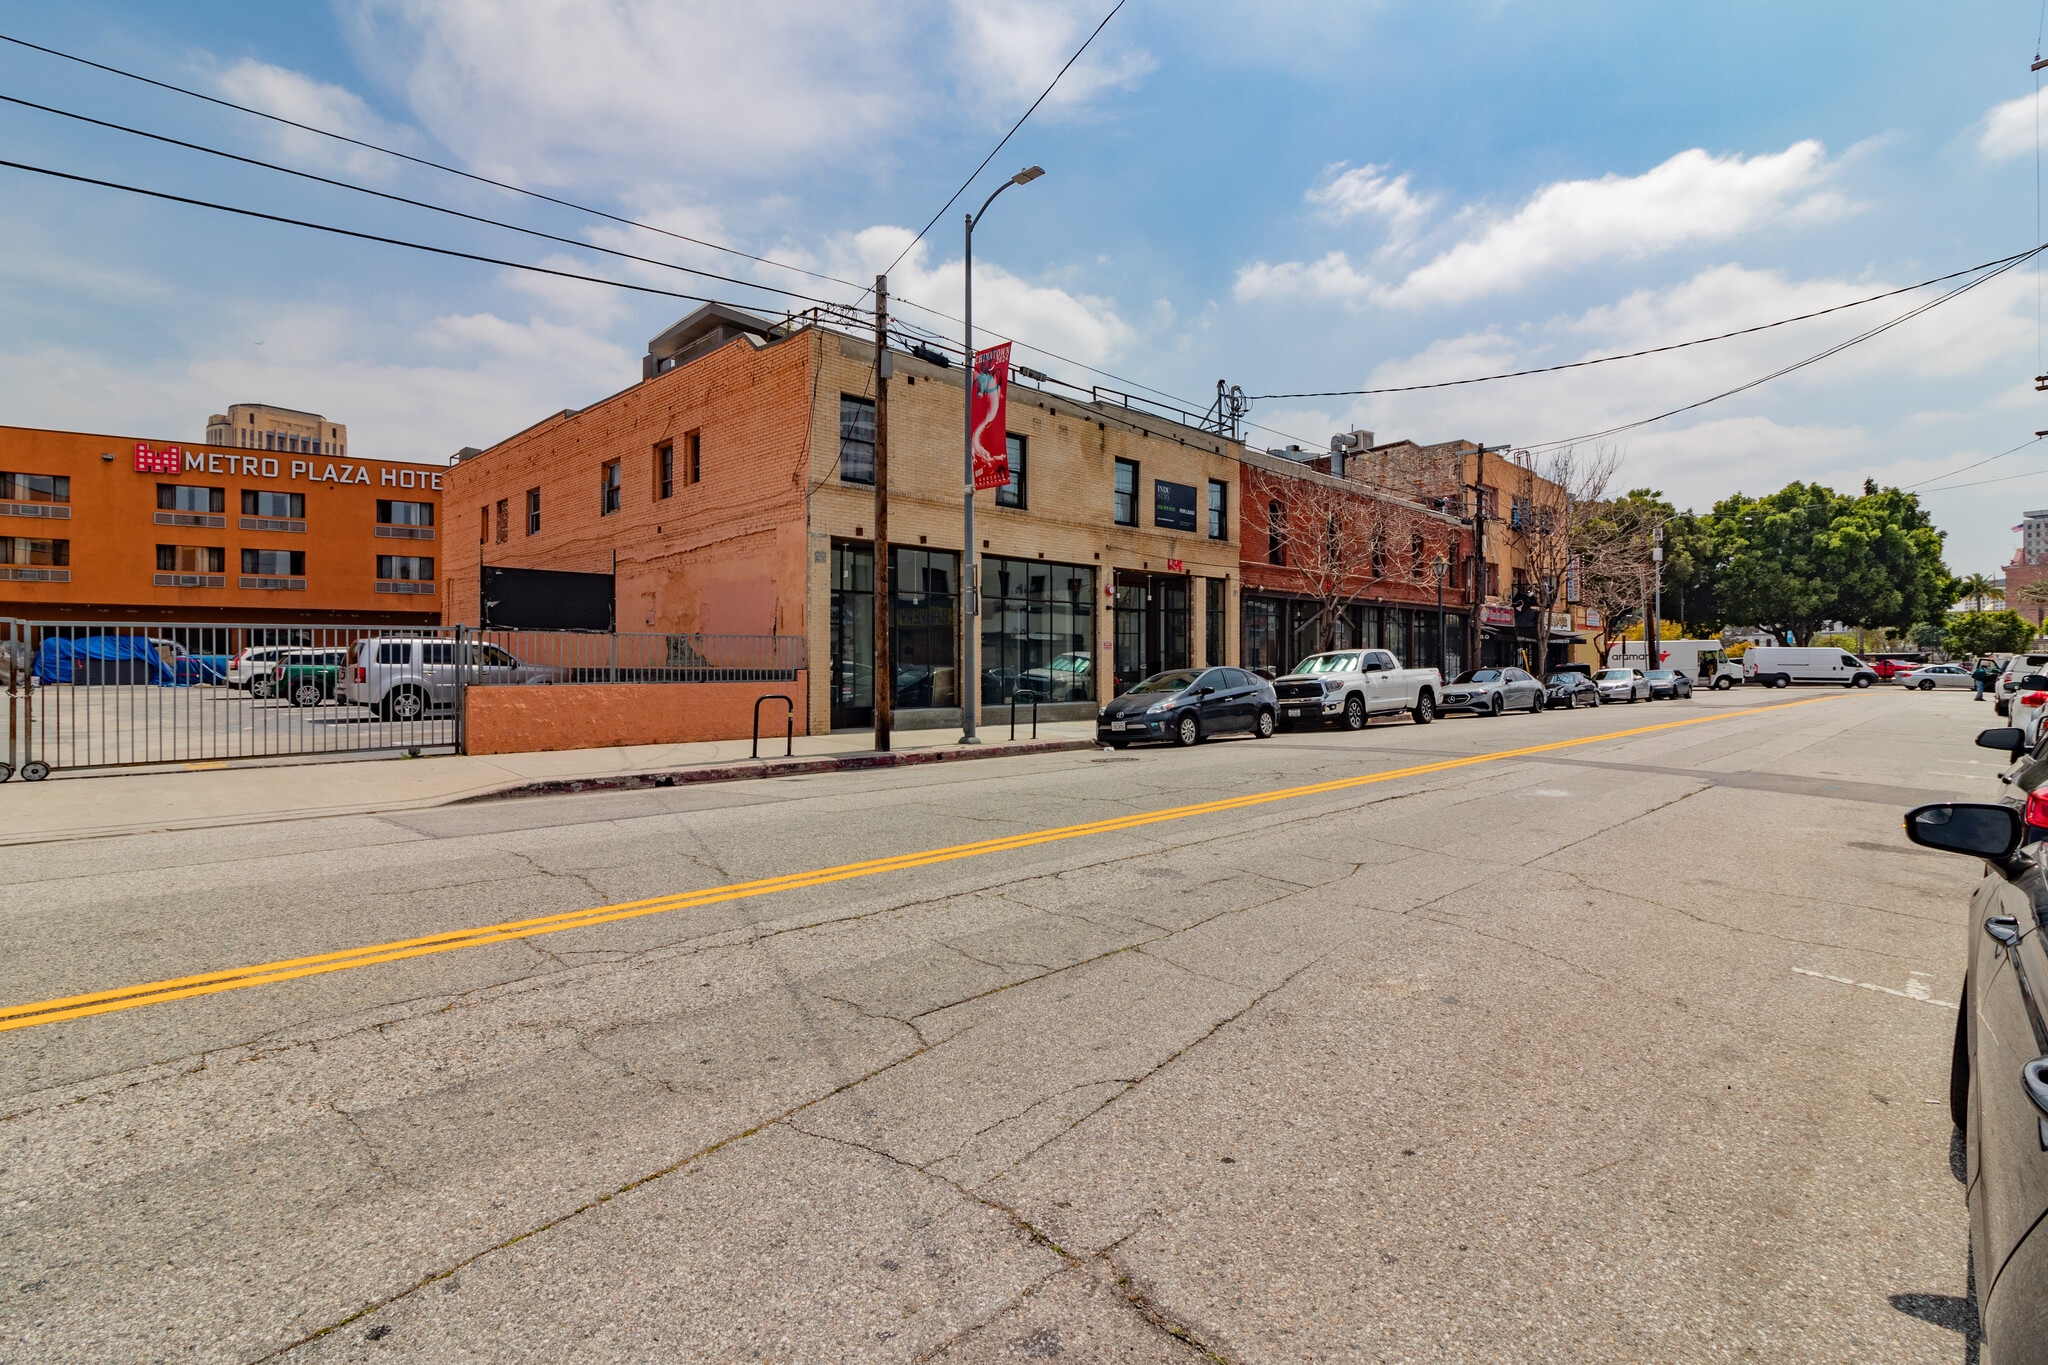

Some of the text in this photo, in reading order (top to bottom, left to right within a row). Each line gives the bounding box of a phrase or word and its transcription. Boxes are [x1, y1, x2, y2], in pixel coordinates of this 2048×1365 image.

[975, 345, 1011, 365] CHINATOWN
[185, 451, 443, 490] METRO PLAZA HOTE
[1157, 485, 1171, 495] INDU
[1611, 653, 1649, 661] aramar
